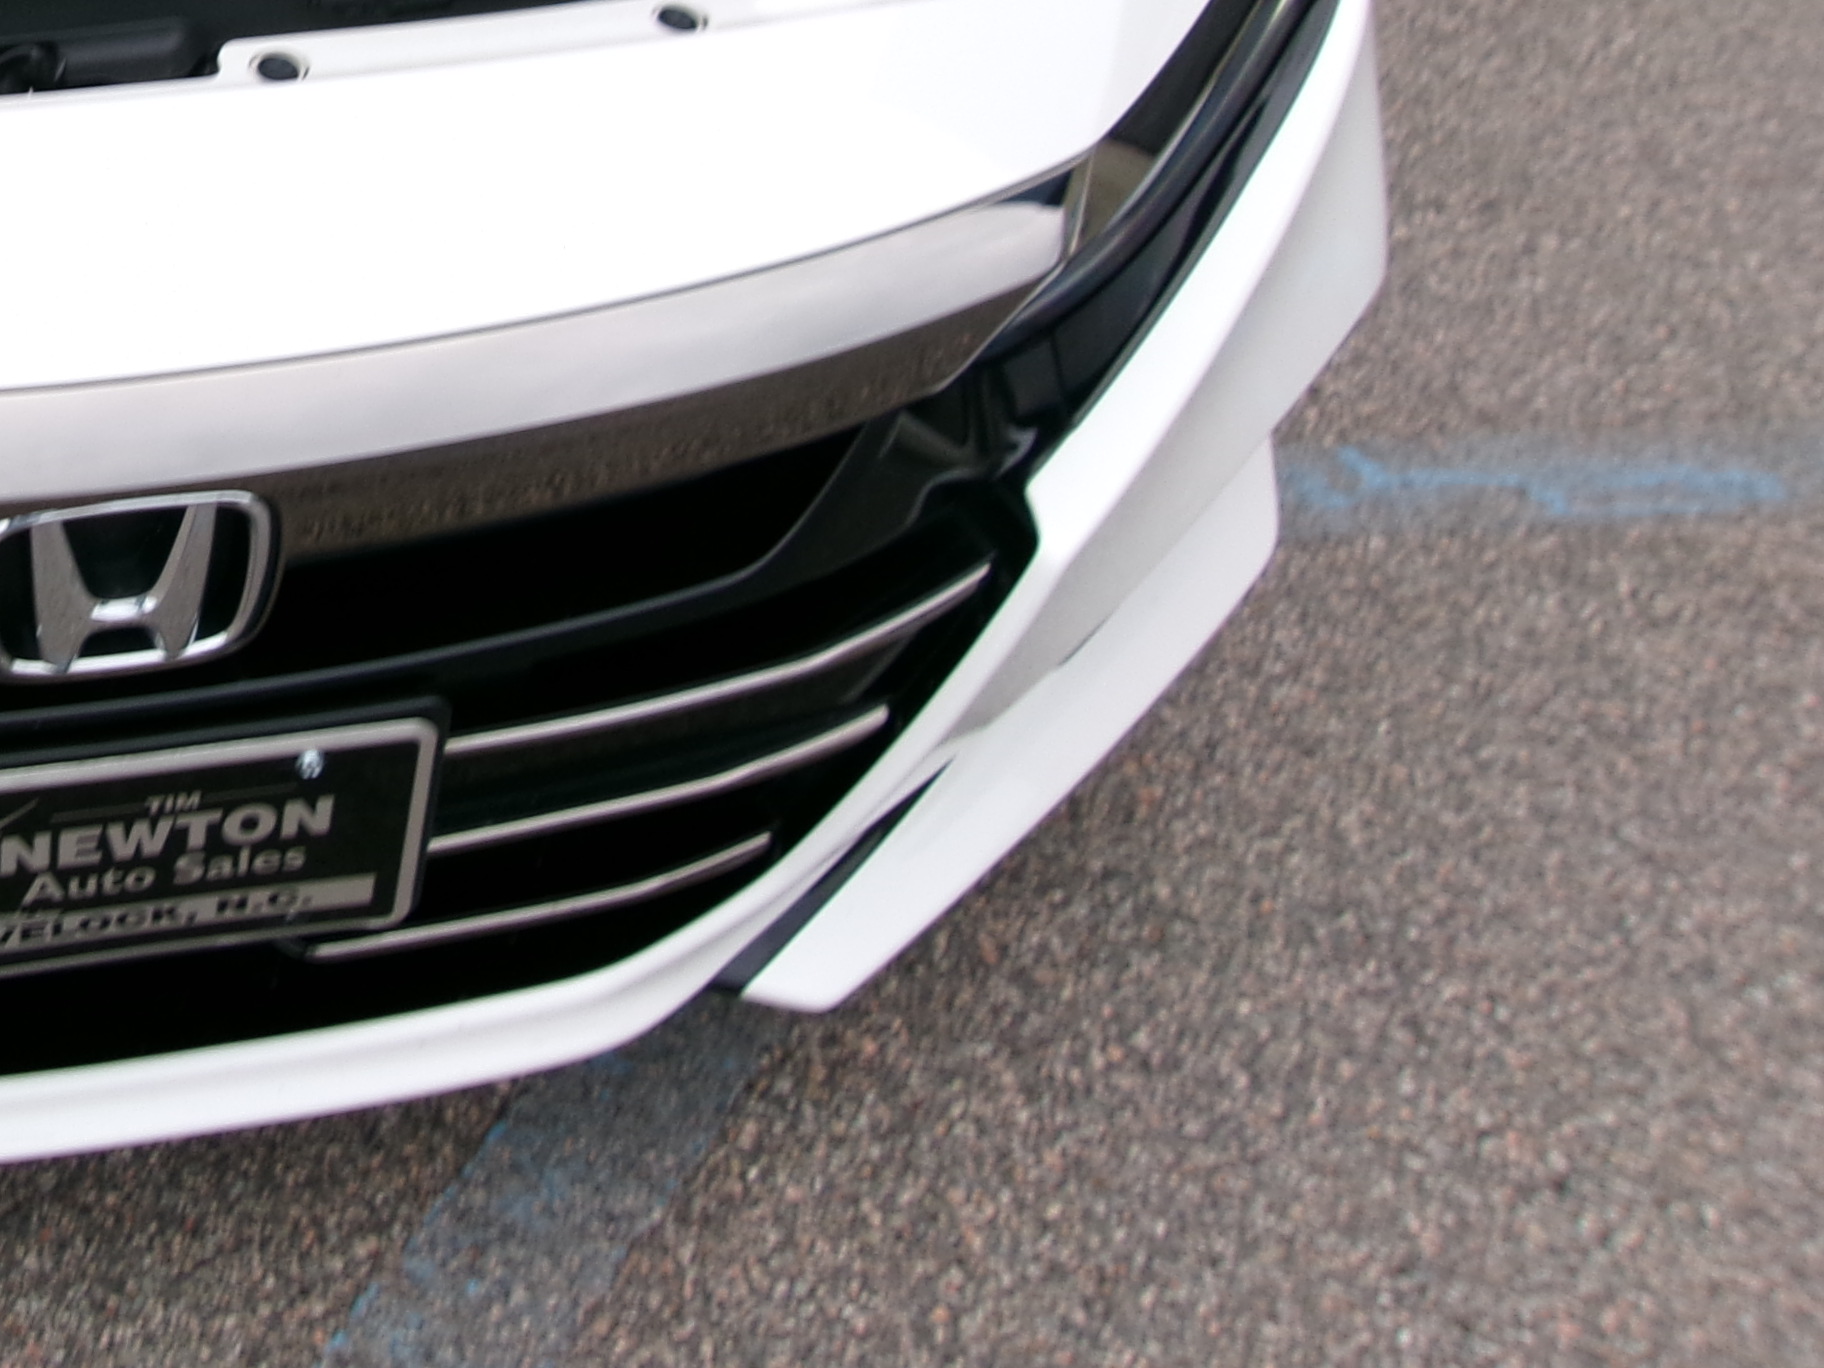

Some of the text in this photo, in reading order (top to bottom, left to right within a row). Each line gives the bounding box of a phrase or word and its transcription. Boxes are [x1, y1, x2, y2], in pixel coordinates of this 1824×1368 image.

[145, 790, 202, 816] TIM
[21, 845, 307, 907] Auto Sales
